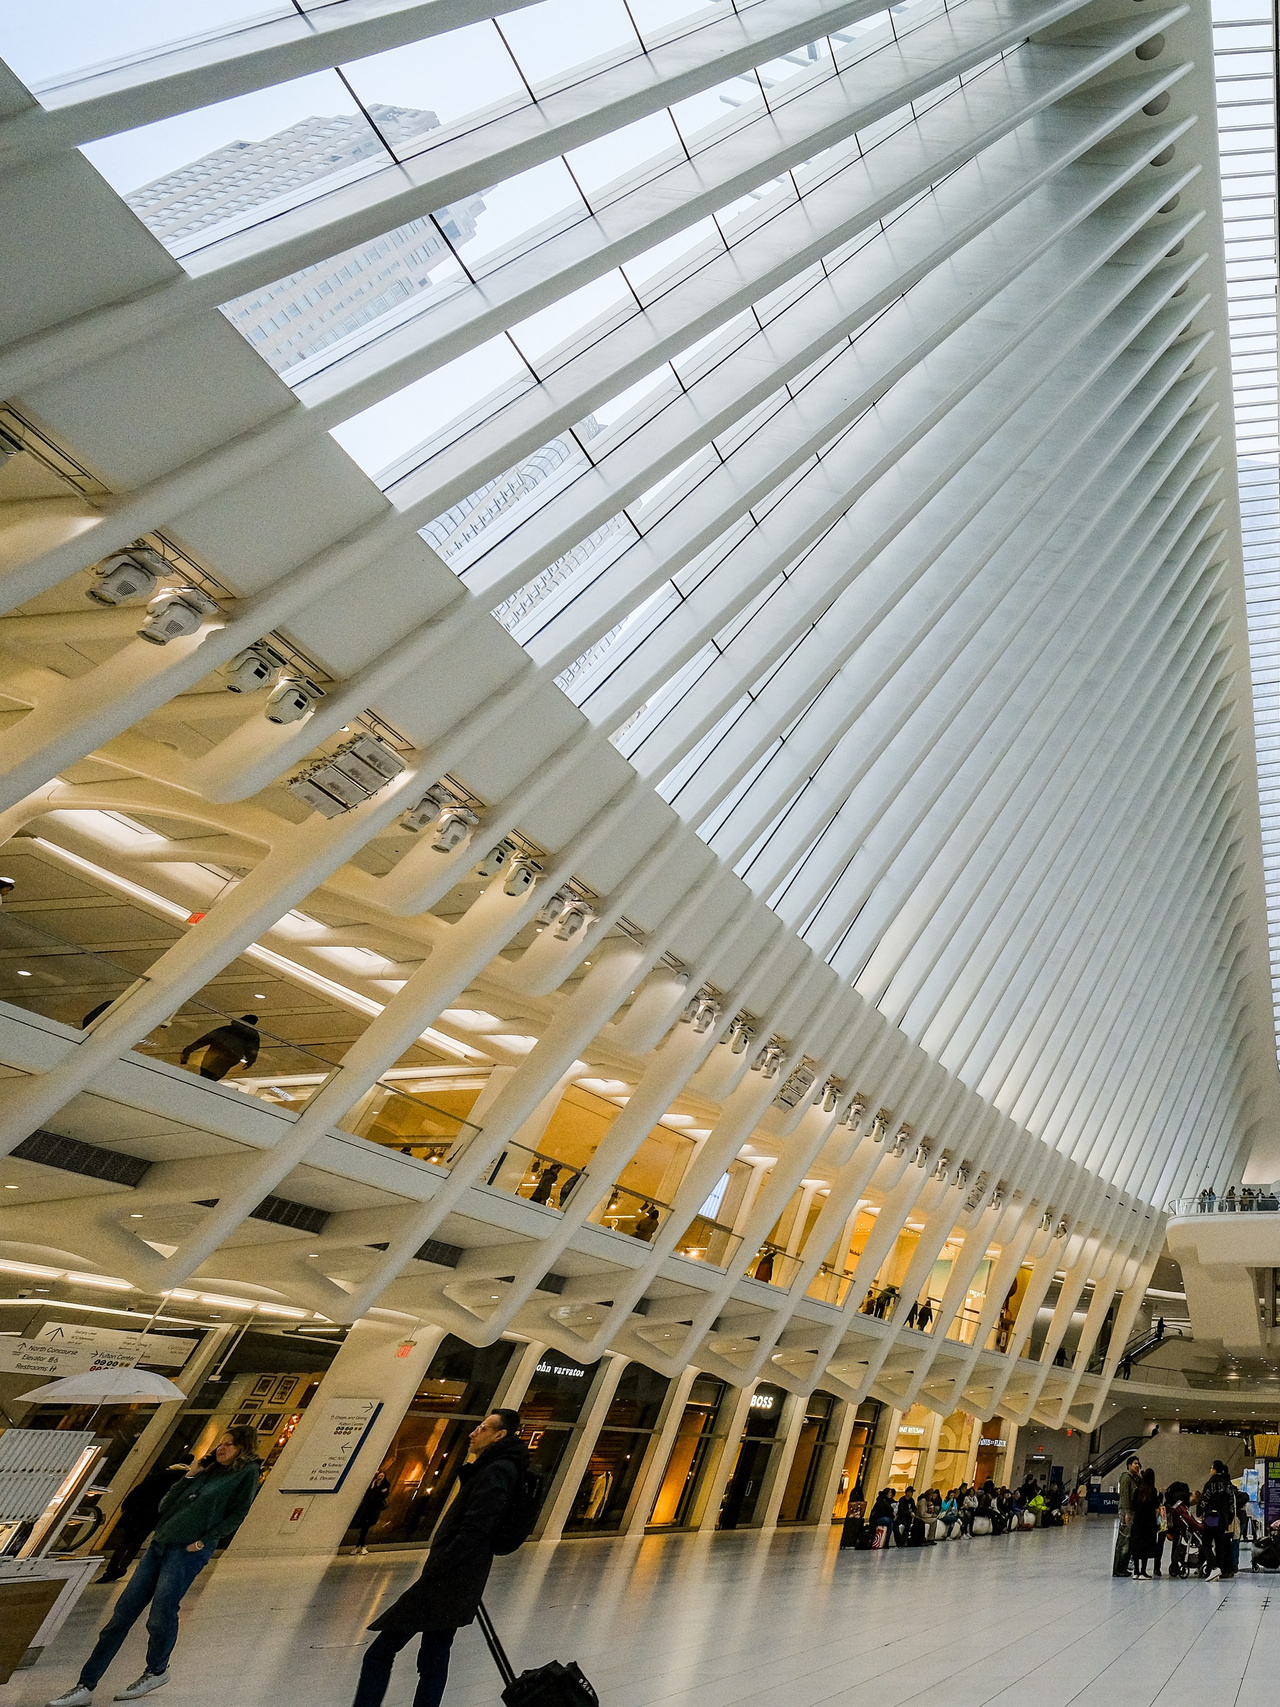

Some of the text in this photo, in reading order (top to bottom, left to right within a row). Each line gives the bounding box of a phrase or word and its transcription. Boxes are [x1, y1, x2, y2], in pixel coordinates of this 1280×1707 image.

[28, 1345, 78, 1356] North Concourse
[22, 1354, 46, 1362] Elevator
[15, 1363, 47, 1371] Restrooms
[536, 1361, 585, 1378] ohn varvatos
[750, 1394, 774, 1409] BOSS
